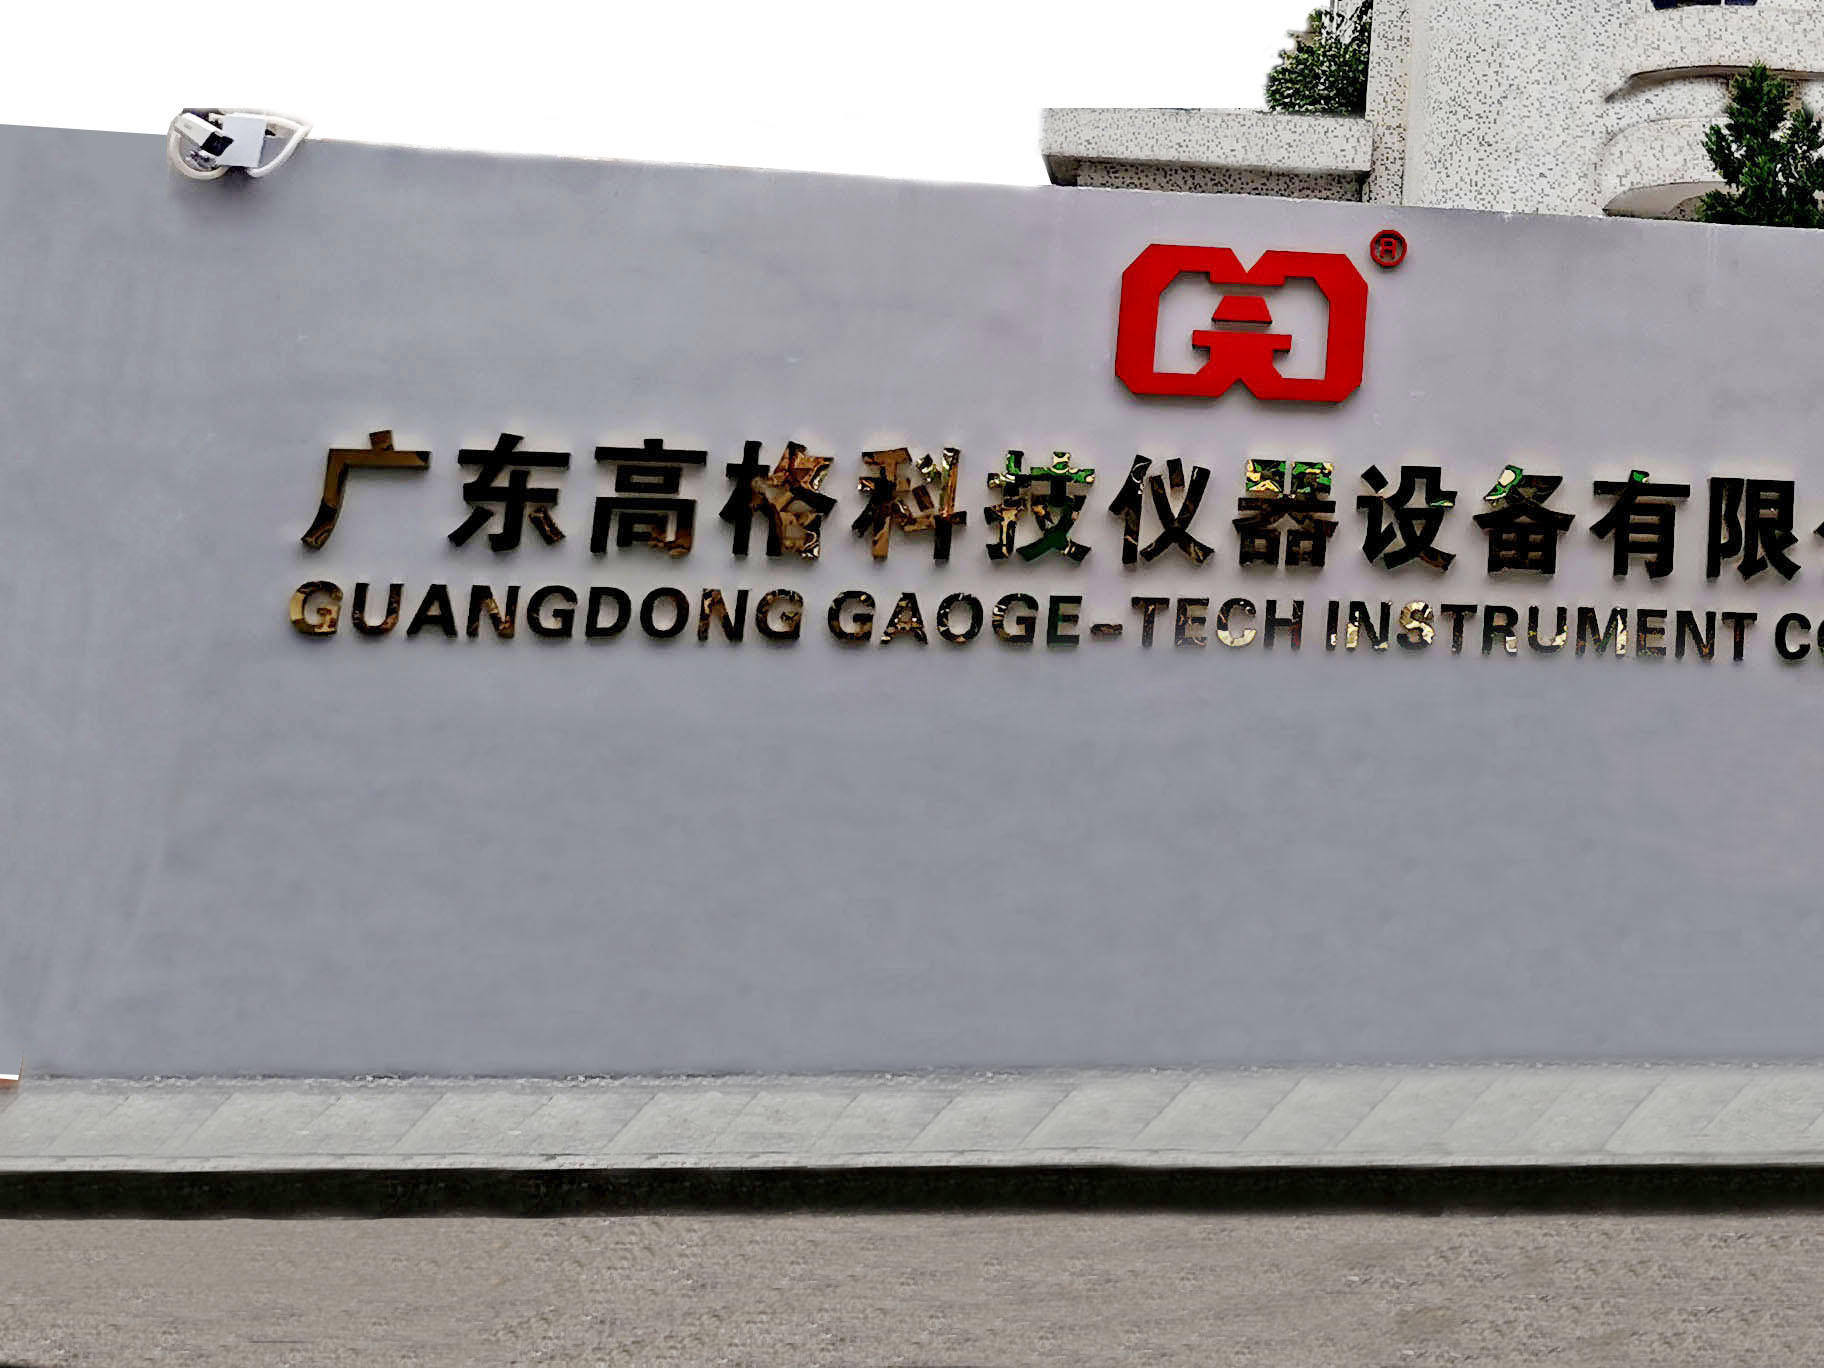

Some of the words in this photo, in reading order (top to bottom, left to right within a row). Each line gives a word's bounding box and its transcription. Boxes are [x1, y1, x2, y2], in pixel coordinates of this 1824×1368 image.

[289, 580, 806, 643] GUANGDONG
[827, 590, 1303, 651] GAOGE-TECH
[1326, 599, 1757, 662] INSTRUMENT
